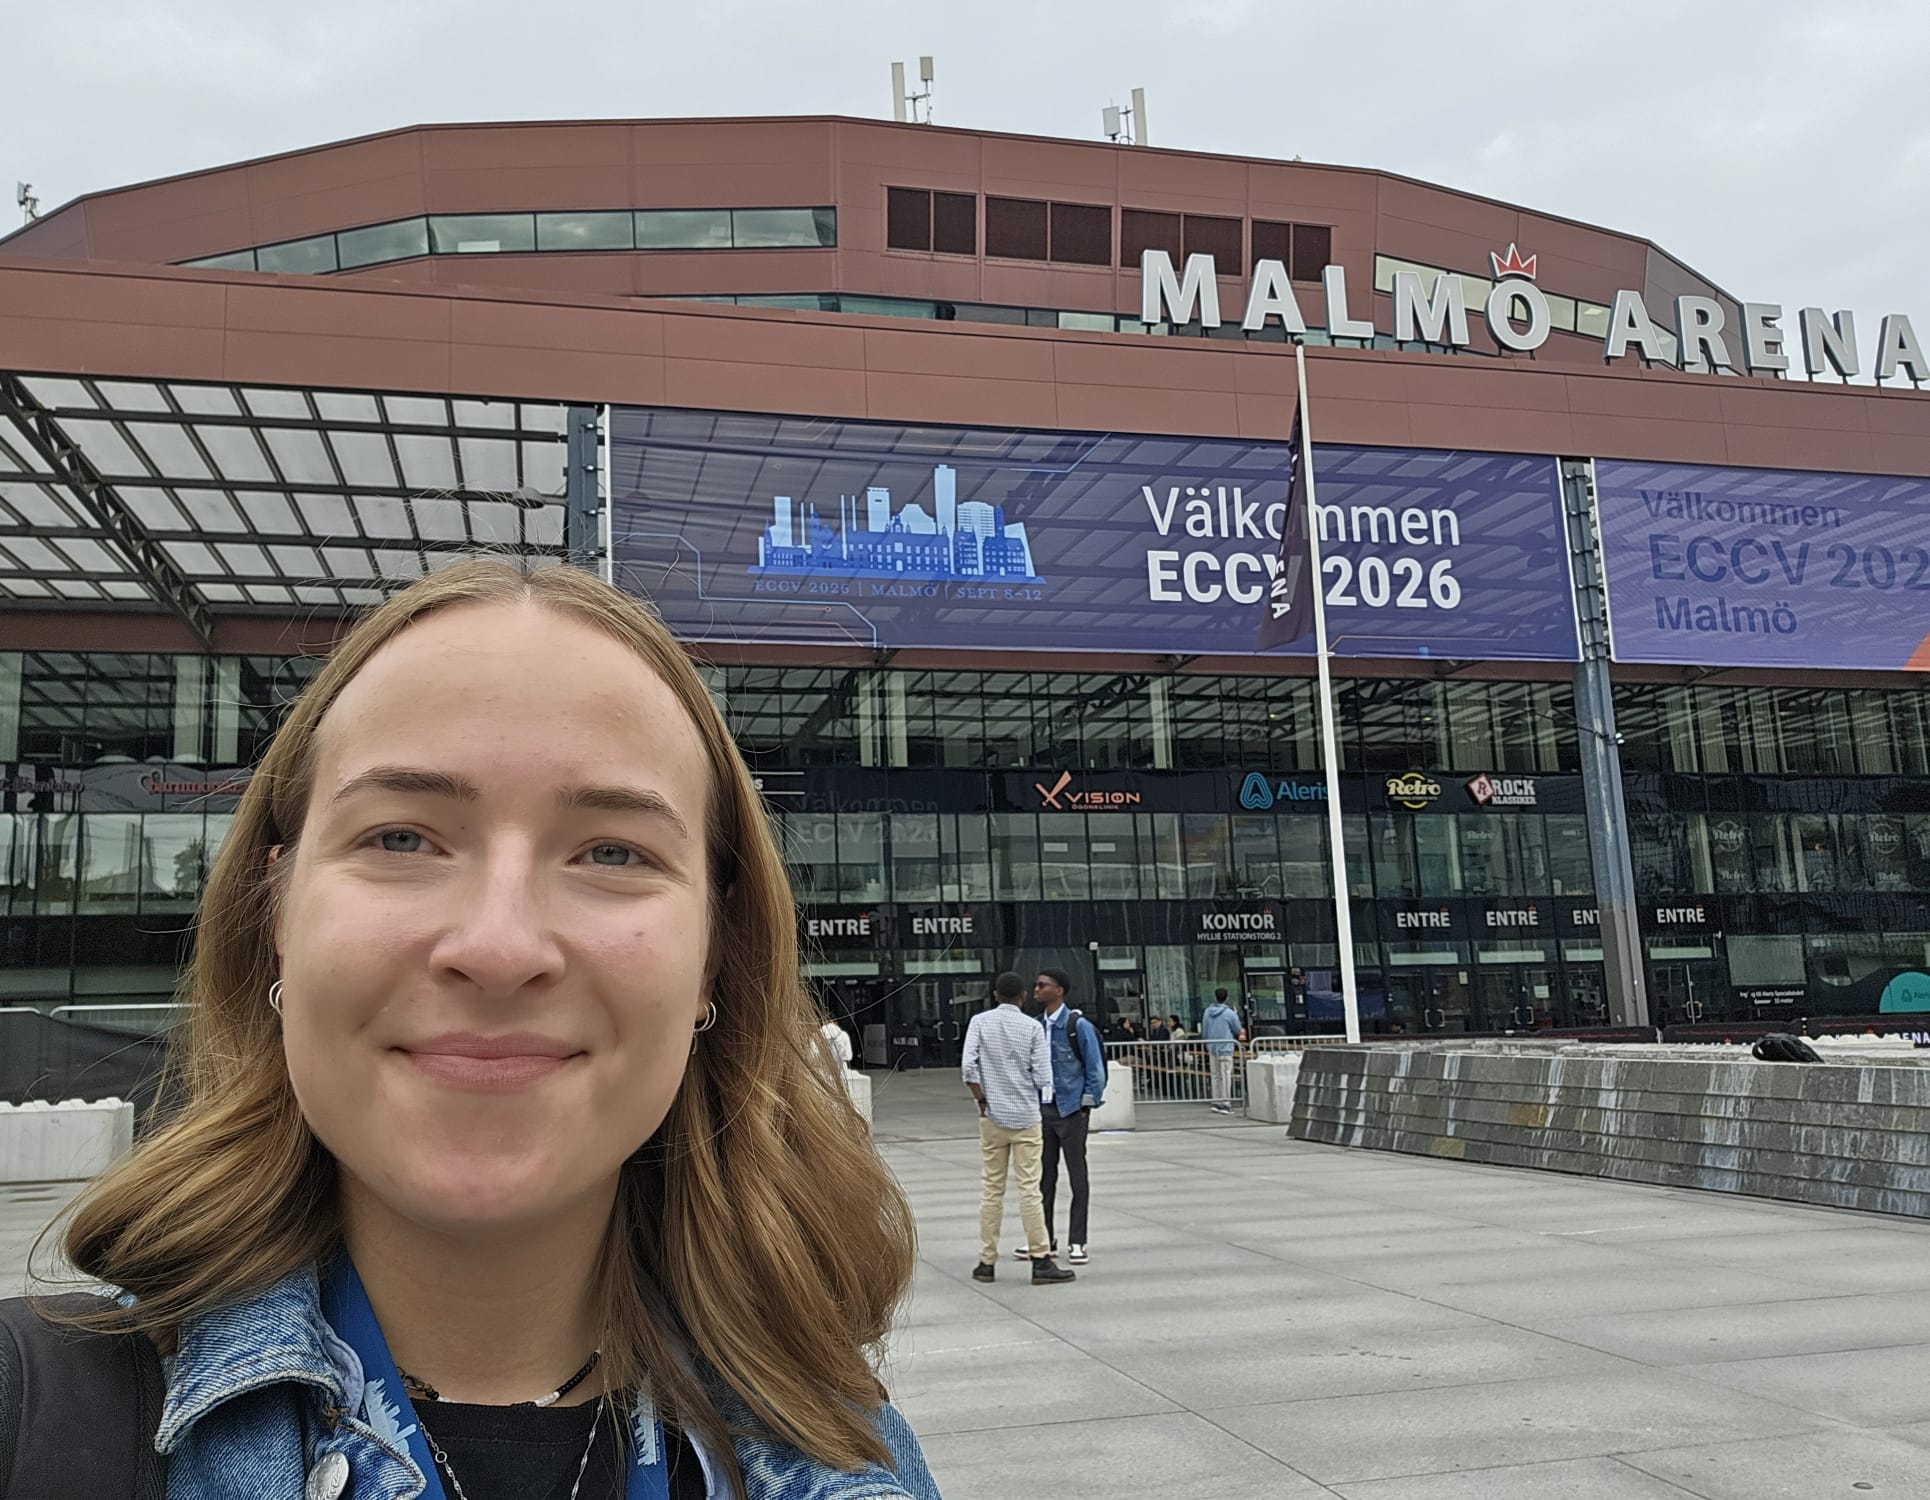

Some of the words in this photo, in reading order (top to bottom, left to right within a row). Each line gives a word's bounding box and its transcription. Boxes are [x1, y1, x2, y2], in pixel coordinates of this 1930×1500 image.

[1604, 289, 1930, 381] ARENA
[1640, 489, 1842, 528] Välkommen
[1649, 534, 1810, 586] ECCV
[1827, 542, 1930, 591] 202
[754, 579, 801, 593] ECCV
[871, 582, 938, 598] MALMÖ
[957, 586, 998, 600] SEPT
[1322, 555, 1461, 609] 2026
[1654, 596, 1798, 635] Malmö
[1386, 778, 1441, 796] Retro
[1490, 779, 1536, 796] ROCK
[1202, 913, 1275, 930] KONTOR
[1572, 909, 1600, 925] ENT
[1196, 932, 1221, 941] HYLLIE
[1223, 931, 1276, 940] STATIONSTORG
